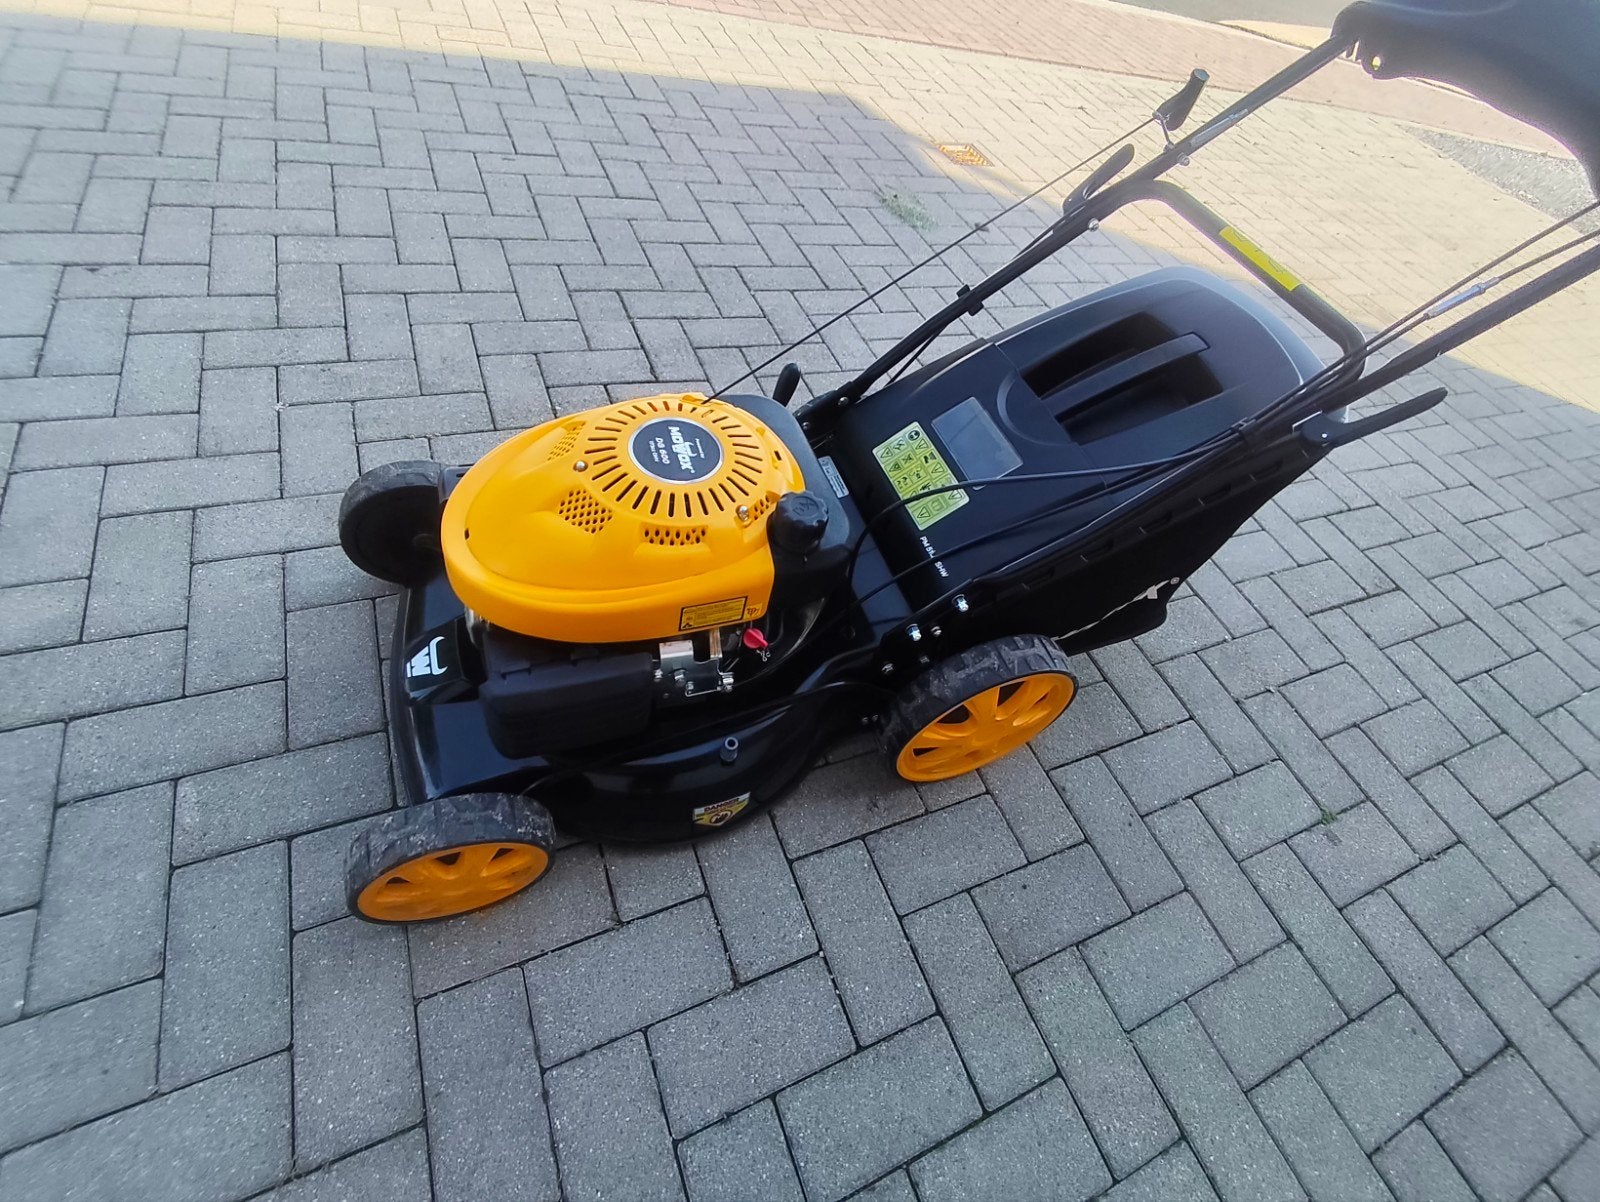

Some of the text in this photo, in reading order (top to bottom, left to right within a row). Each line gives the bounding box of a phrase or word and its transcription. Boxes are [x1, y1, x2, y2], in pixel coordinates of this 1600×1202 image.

[659, 449, 670, 464] 600
[667, 426, 694, 470] MOWOX
[920, 536, 930, 547] PM
[934, 561, 949, 577] SHW
